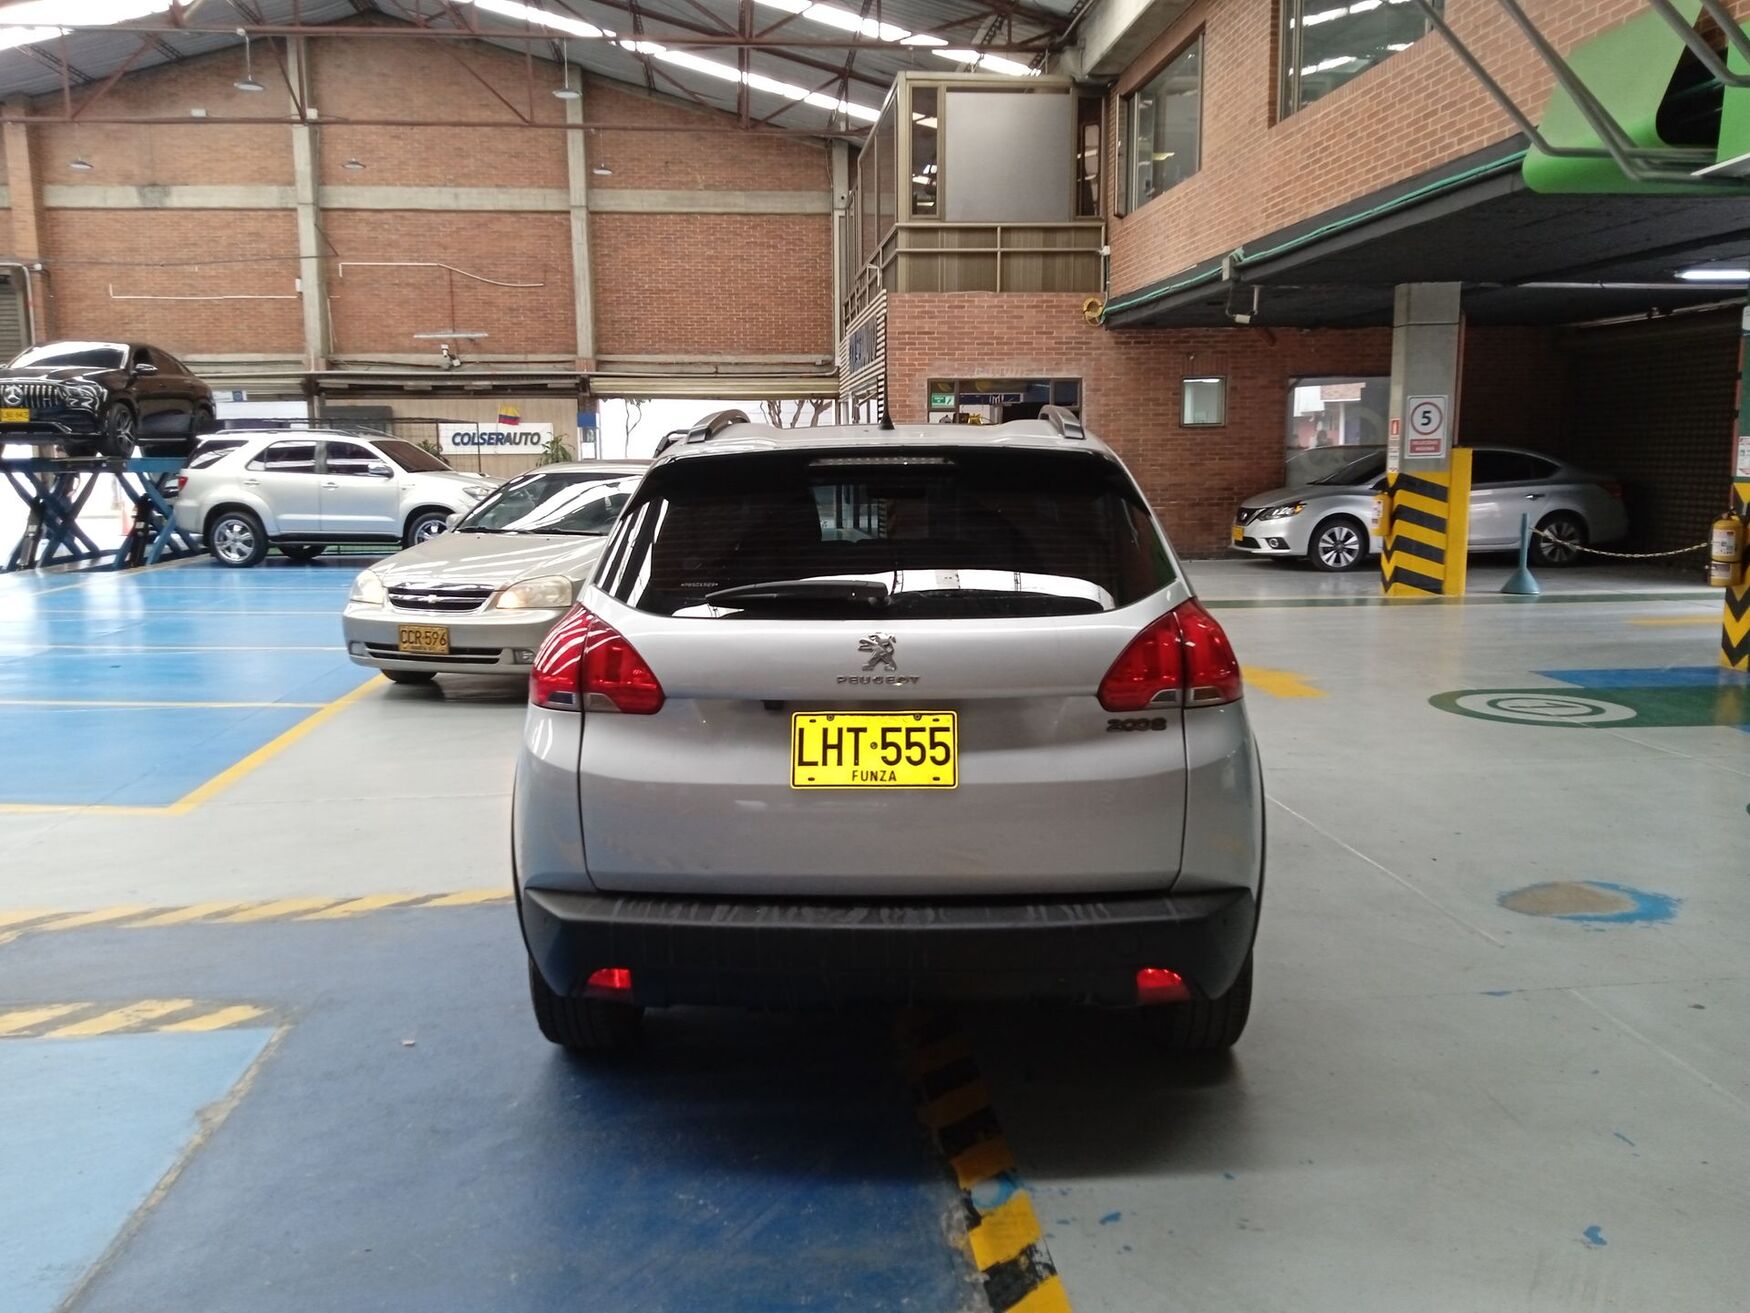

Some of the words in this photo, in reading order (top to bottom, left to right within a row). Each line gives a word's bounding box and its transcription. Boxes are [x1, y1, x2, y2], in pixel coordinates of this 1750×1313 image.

[1421, 410, 1432, 426] 5
[452, 431, 541, 446] COLSERAUTO
[836, 676, 920, 685] PEUGEOT
[851, 770, 897, 782] FUNZA
